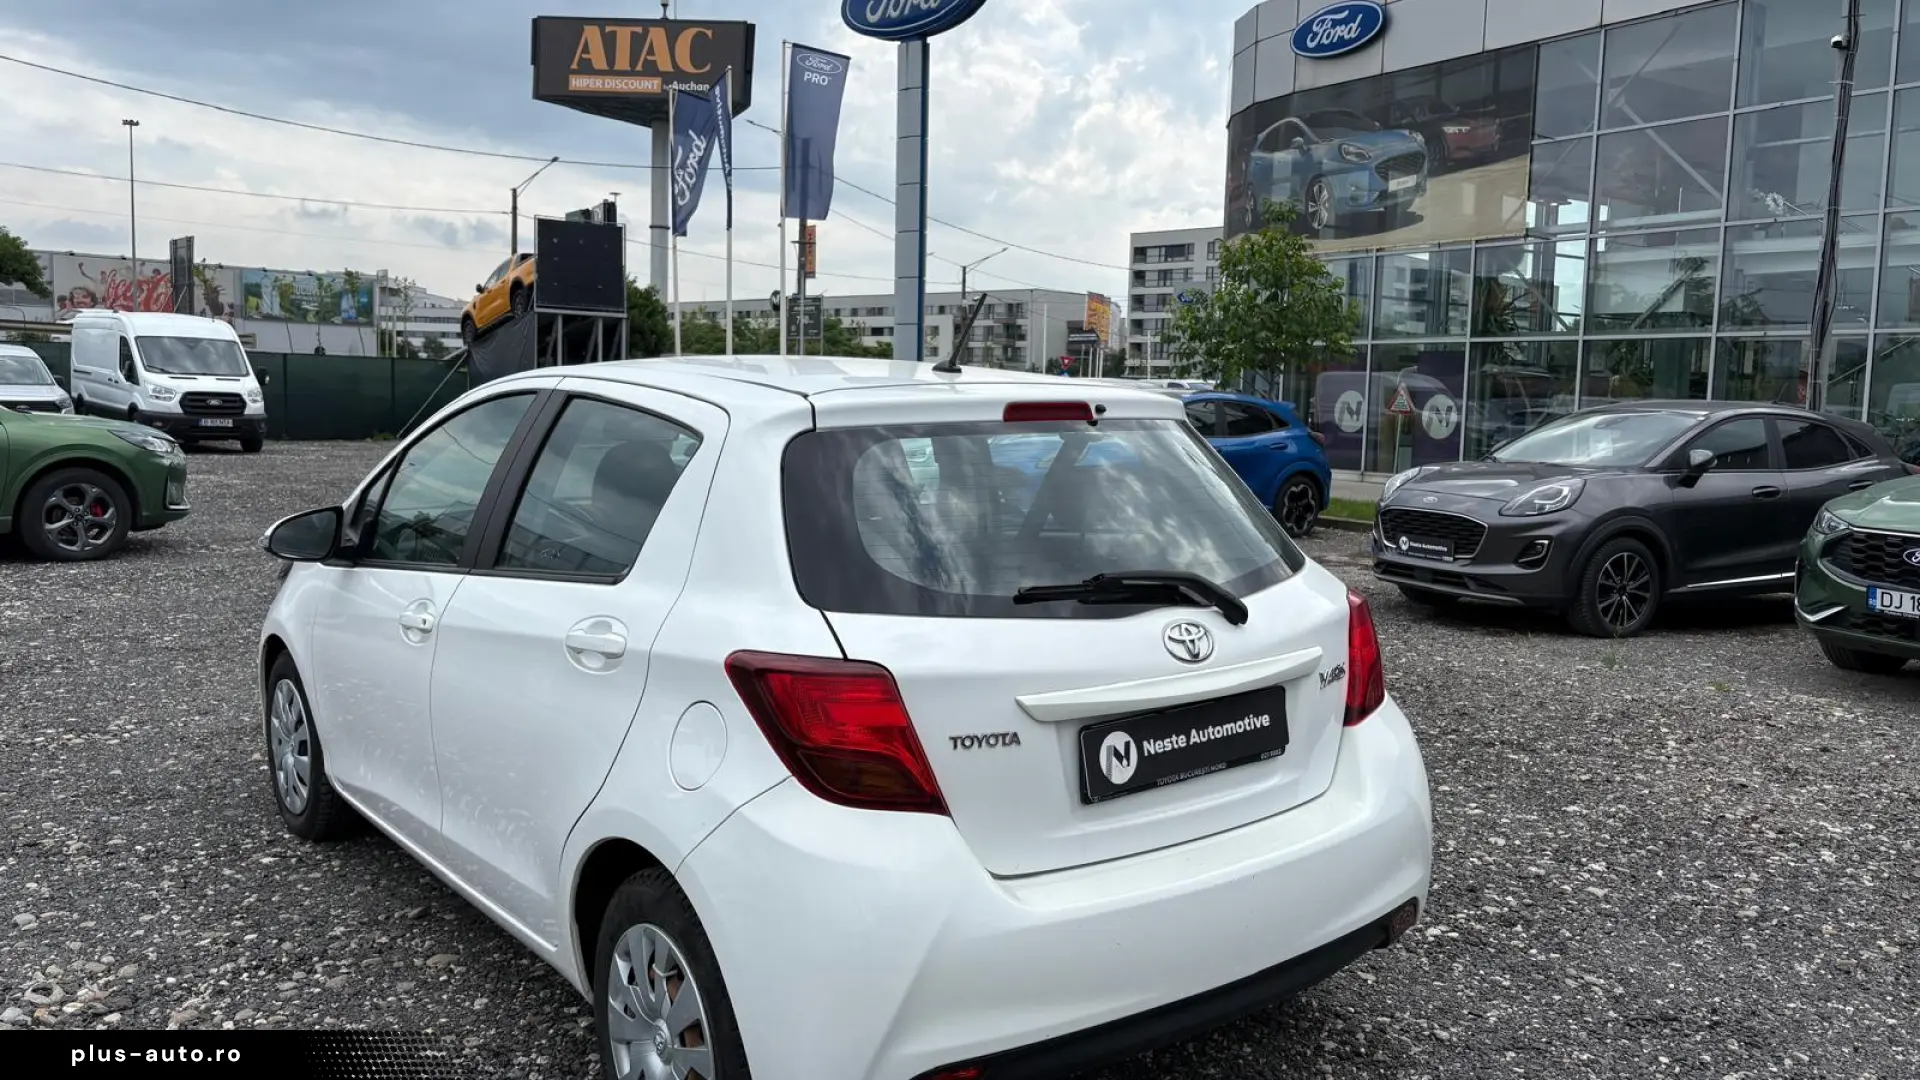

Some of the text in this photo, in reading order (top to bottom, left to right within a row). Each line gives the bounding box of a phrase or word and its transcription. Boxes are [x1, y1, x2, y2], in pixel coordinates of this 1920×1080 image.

[1306, 9, 1363, 48] Ford
[569, 24, 713, 73] ATAC
[804, 56, 834, 71] Ford
[571, 77, 660, 91] HIPER DISCOUNT
[671, 80, 710, 92] Auchan
[674, 129, 707, 206] Ford
[1881, 591, 1903, 609] DJ
[948, 731, 1021, 751] TOYOTA
[1143, 733, 1187, 757] Neste
[1189, 713, 1271, 746] Automotive
